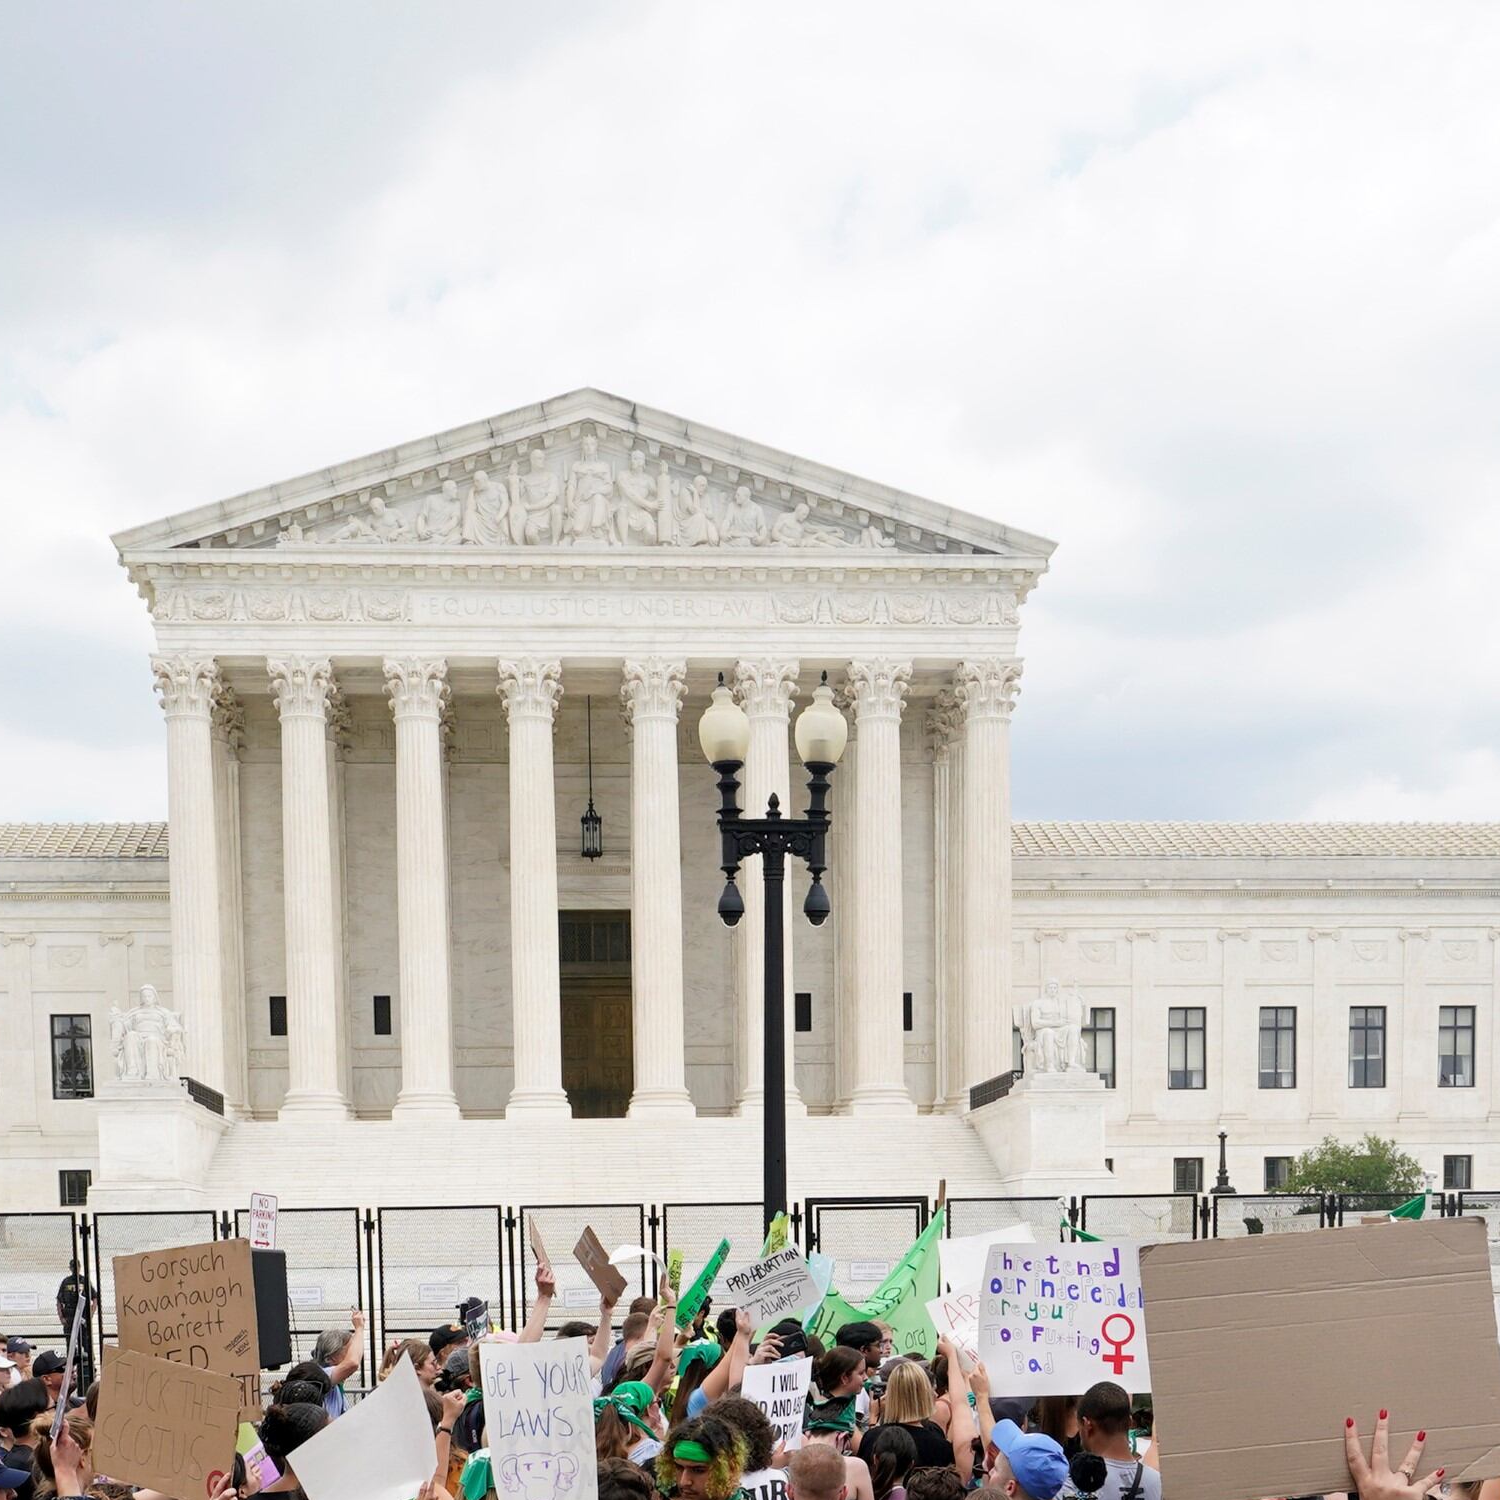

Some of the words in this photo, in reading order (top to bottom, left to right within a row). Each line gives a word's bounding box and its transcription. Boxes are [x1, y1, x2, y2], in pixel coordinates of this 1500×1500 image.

[429, 598, 508, 617] EQUAL
[515, 597, 608, 617] JUSTICE
[621, 598, 699, 617] UNDER
[707, 598, 754, 617] LAW
[252, 1208, 275, 1220] PARKING
[258, 1198, 269, 1208] NO
[256, 1230, 268, 1239] TIME
[257, 1222, 269, 1230] ANY
[140, 1247, 225, 1283] Gorsuch
[991, 1247, 1120, 1277] Threatened
[122, 1277, 243, 1317] Kavanaugh
[990, 1277, 1027, 1295] our
[987, 1298, 1021, 1317] are
[1024, 1301, 1077, 1326] you?
[147, 1308, 225, 1346] Barrett
[983, 1323, 1024, 1346] Too
[1011, 1351, 1055, 1375] Bad
[533, 1354, 591, 1399] YOUR
[772, 1375, 776, 1393] I
[779, 1372, 799, 1393] WILL
[114, 1359, 171, 1415] FUCK
[179, 1378, 223, 1429] THE
[770, 1399, 792, 1418] AND
[498, 1405, 574, 1439] LAWS
[101, 1412, 205, 1481] SCOTUS
